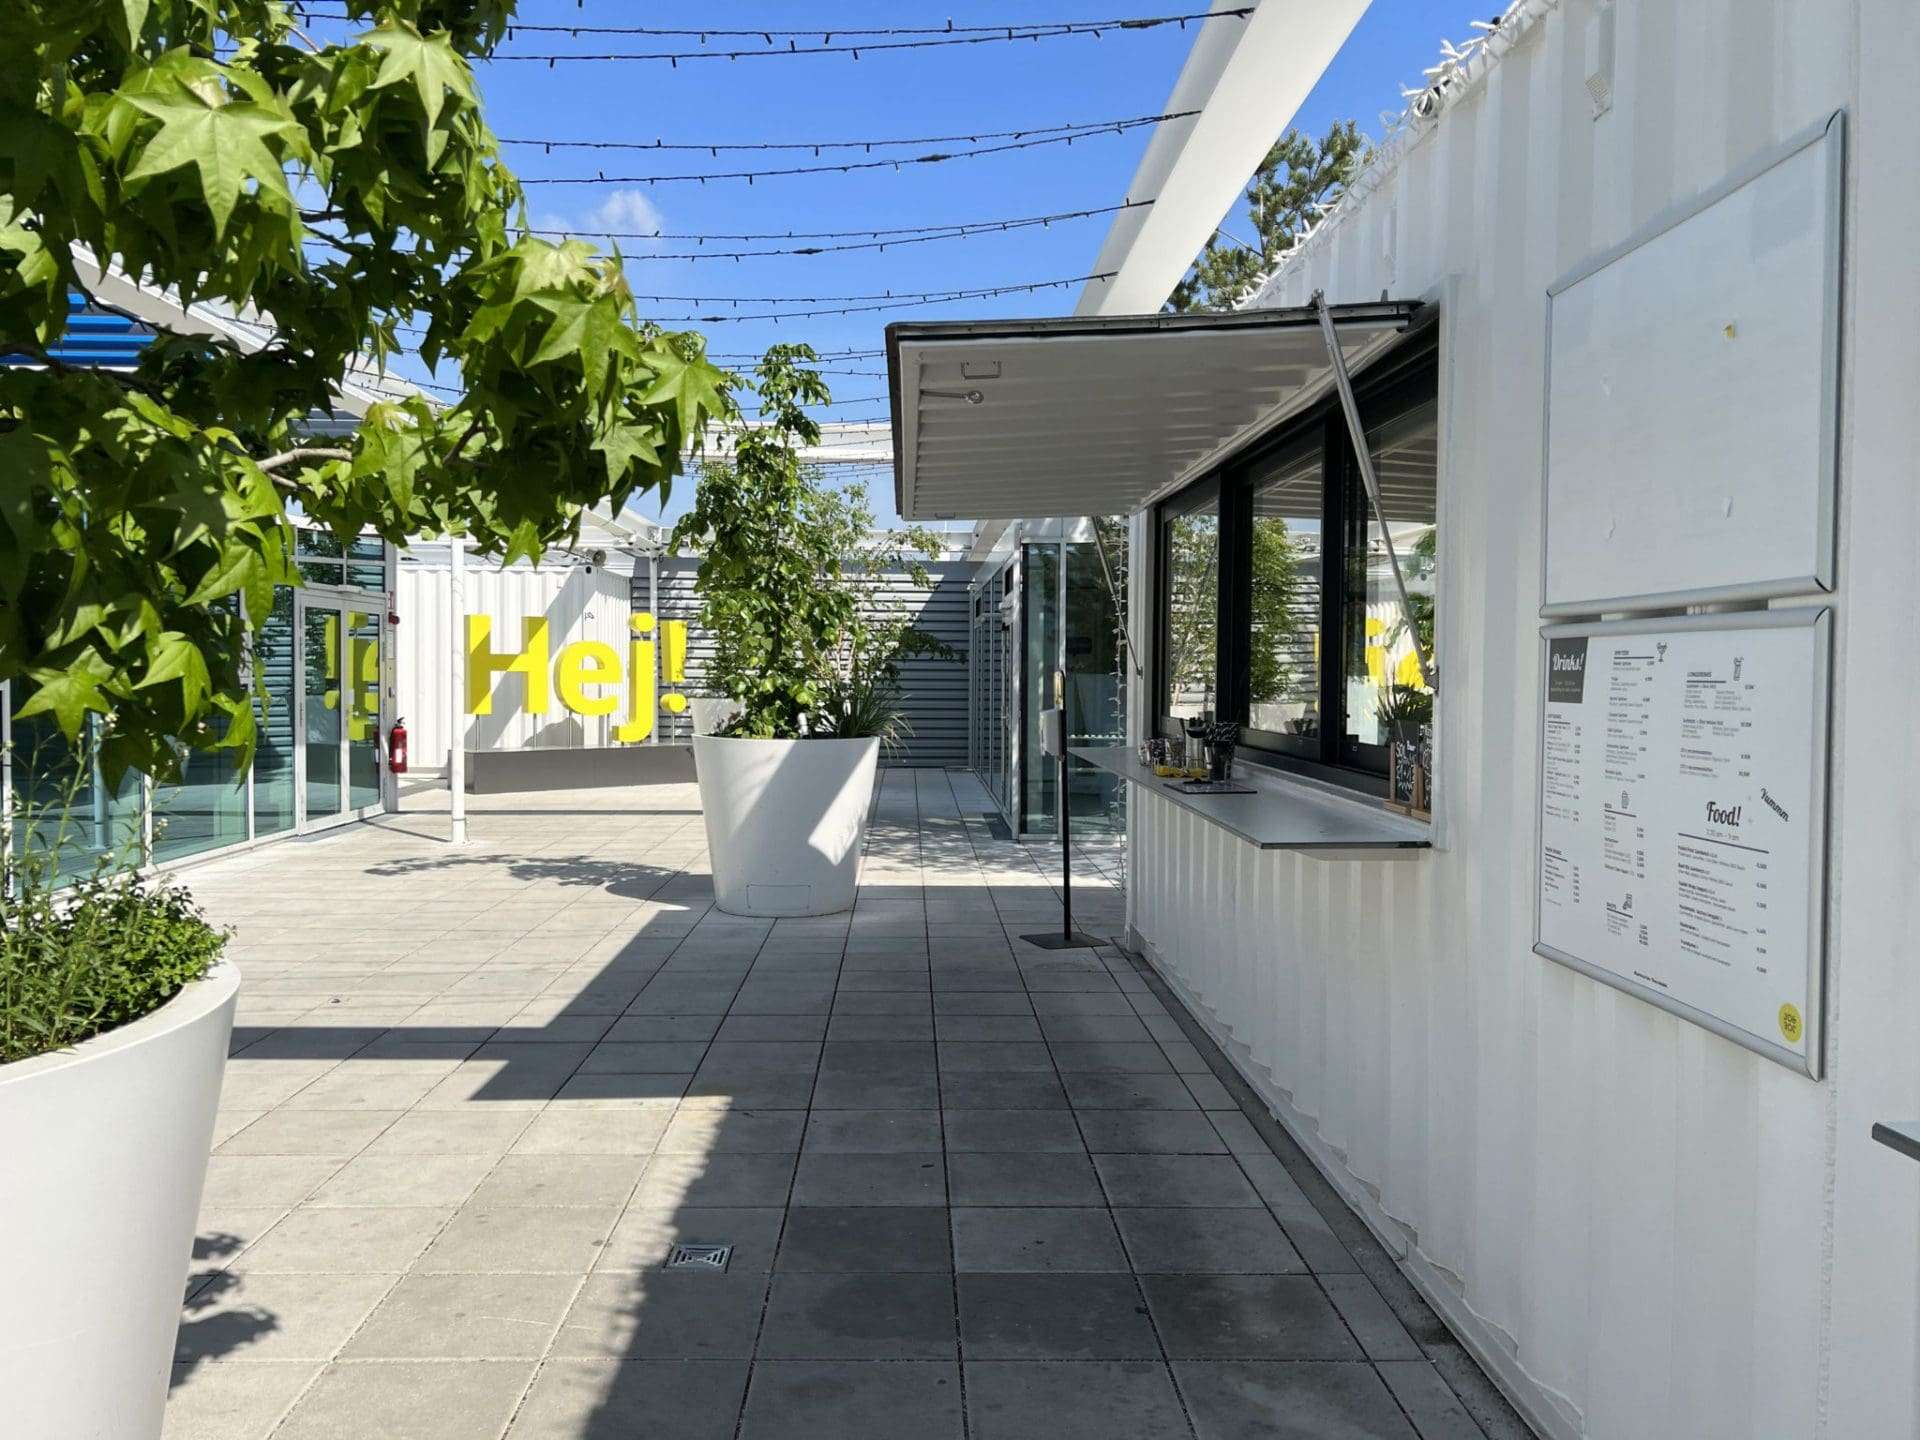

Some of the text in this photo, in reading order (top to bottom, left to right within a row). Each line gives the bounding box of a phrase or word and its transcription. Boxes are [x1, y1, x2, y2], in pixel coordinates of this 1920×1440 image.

[1552, 653, 1584, 671] Drinks!
[464, 612, 687, 743] Hej!
[1706, 801, 1741, 827] Food!
[1760, 788, 1789, 822] Yummm
